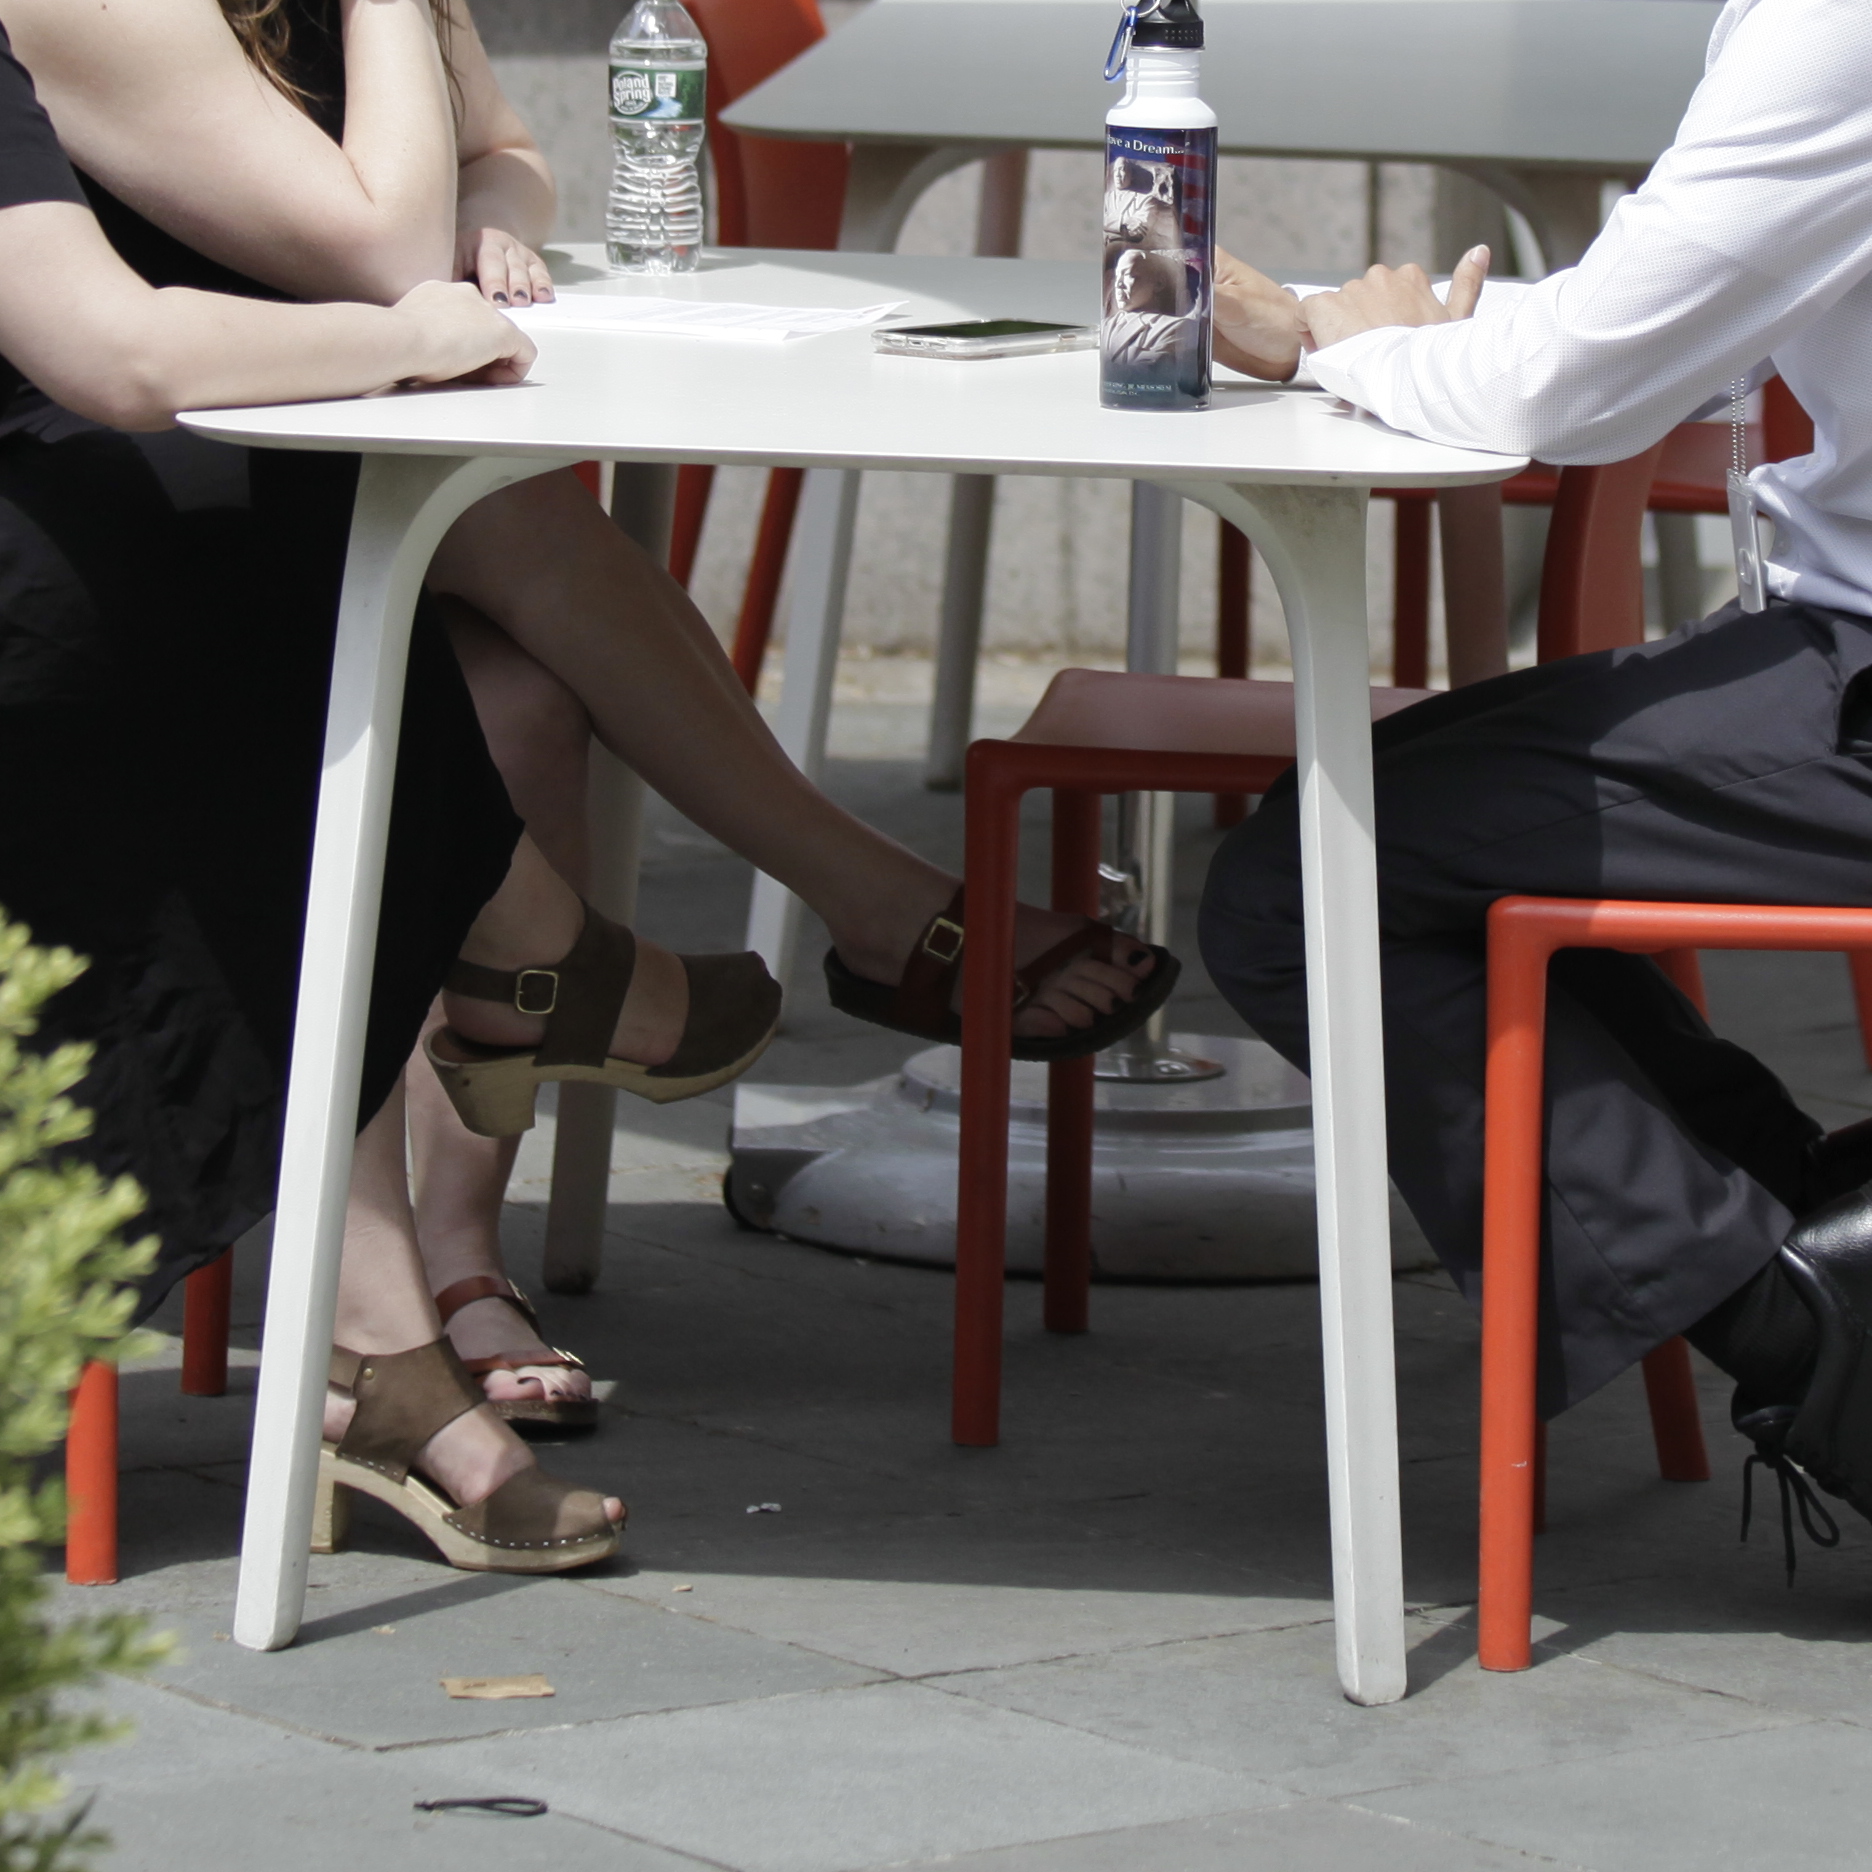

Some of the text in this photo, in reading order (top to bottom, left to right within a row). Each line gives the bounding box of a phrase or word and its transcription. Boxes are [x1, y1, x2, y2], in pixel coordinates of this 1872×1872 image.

[612, 73, 650, 90] Poland
[612, 89, 651, 108] Spring
[1124, 140, 1131, 149] a
